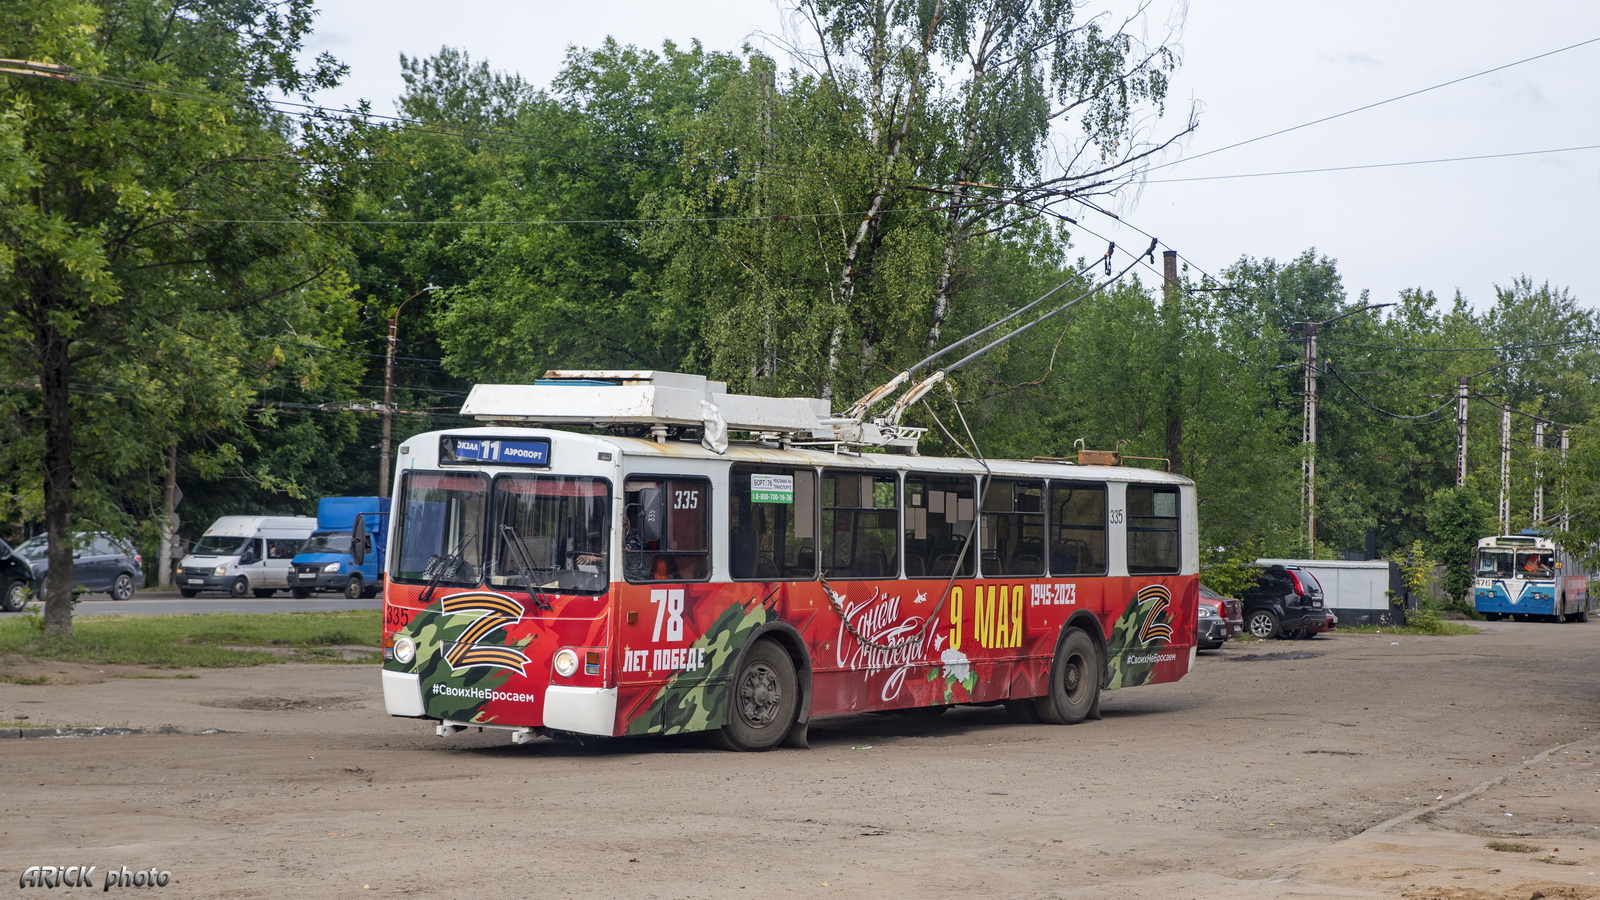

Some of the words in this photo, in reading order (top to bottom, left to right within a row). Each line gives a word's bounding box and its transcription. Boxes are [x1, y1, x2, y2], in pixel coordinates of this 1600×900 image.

[481, 440, 500, 460] 11
[504, 447, 542, 459] АЭРОПОРТ
[674, 490, 698, 510] 335
[1110, 509, 1123, 524] 335
[1030, 583, 1076, 605] 1945-2023
[387, 605, 408, 626] 335
[650, 588, 685, 643] 78
[949, 586, 963, 651] 9
[974, 584, 1025, 649] МАЯ
[623, 650, 649, 672] ЛЕТ
[653, 647, 705, 672] ПОБЕДЕ
[1127, 653, 1176, 665] #СвоихНеБросаем
[432, 684, 534, 702] #СвоихНеБросаем
